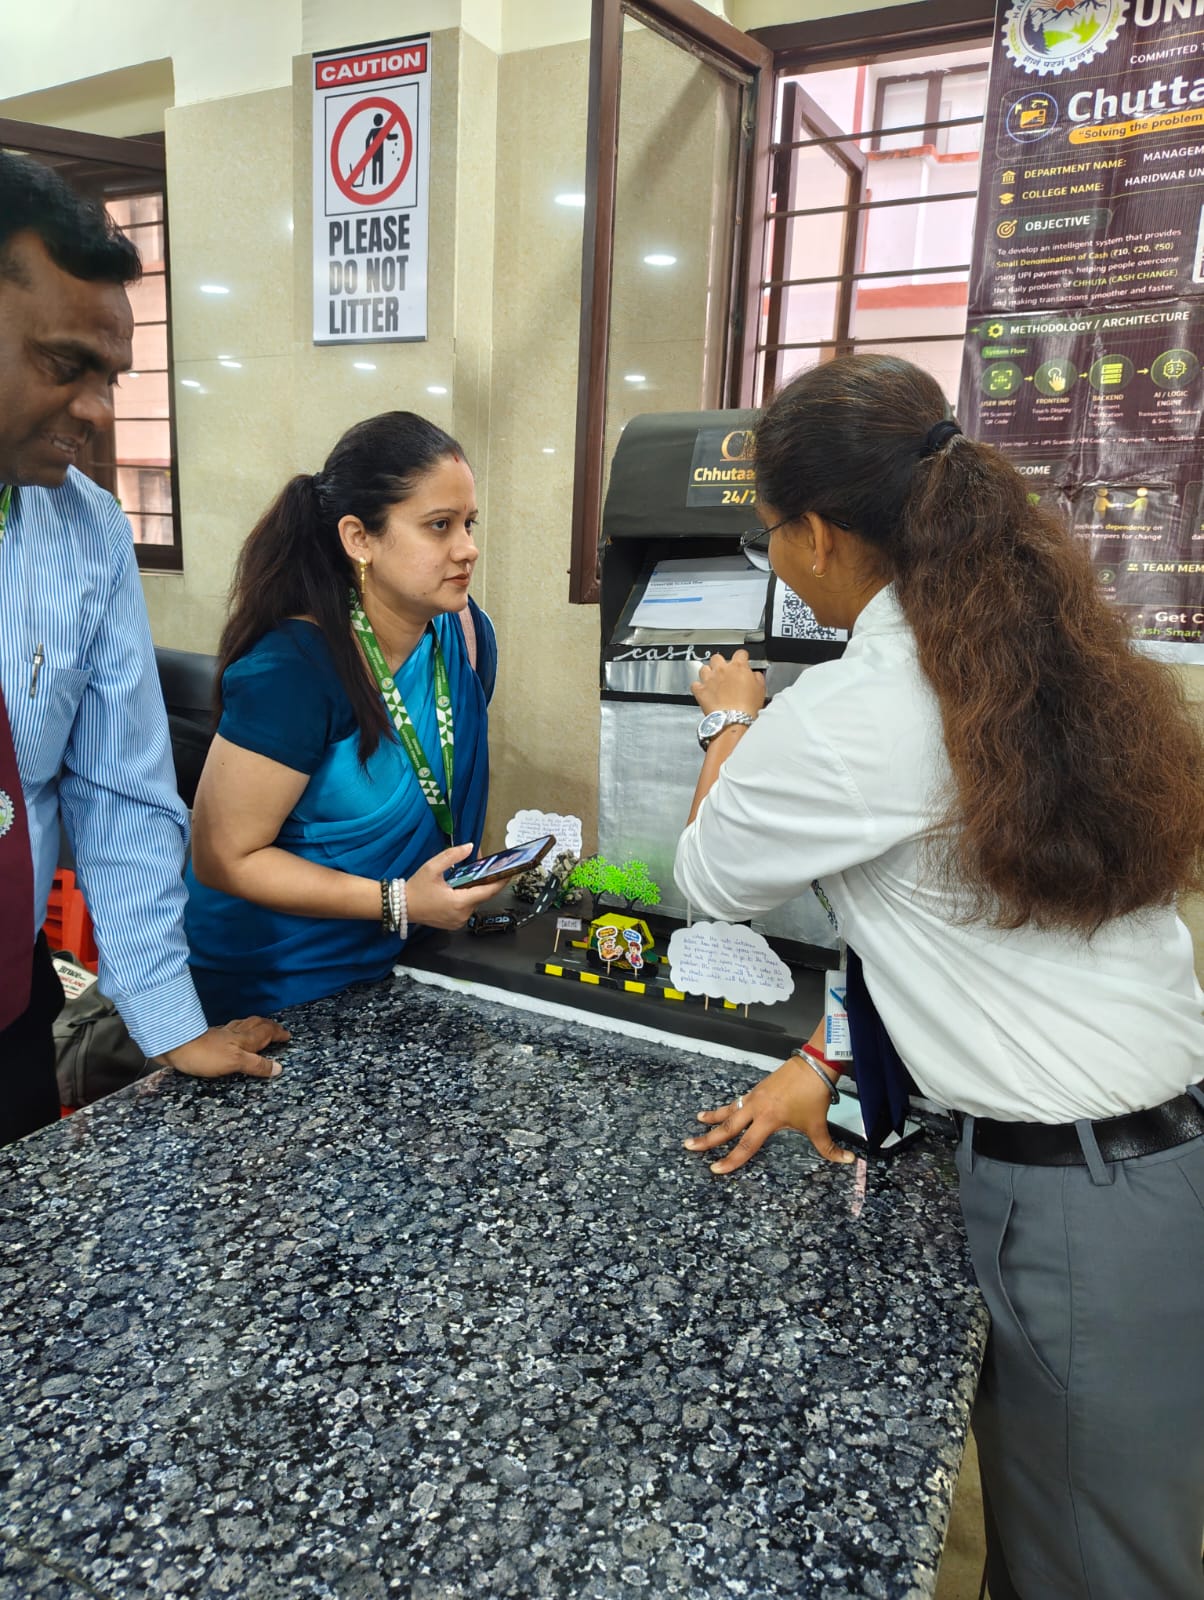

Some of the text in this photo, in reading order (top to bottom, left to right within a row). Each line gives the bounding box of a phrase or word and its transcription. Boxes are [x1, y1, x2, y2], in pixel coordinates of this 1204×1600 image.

[1130, 44, 1198, 64] COMMITTED
[321, 52, 421, 82] CAUTION
[1068, 75, 1204, 122] Chutta
[1130, 121, 1148, 132] the
[1152, 113, 1203, 130] problem
[1024, 163, 1090, 179] DEPARTMENT
[1093, 159, 1126, 170] NAME:
[1022, 186, 1071, 200] COLLEGE
[1073, 182, 1104, 194] NAME:
[1124, 170, 1185, 187] HARIDWAR
[1025, 215, 1091, 231] OBJECTIVE
[329, 214, 410, 256] PLEASE
[1008, 245, 1039, 255] develop
[1052, 240, 1093, 251] intelligent
[1095, 236, 1123, 247] system
[1125, 233, 1143, 242] that
[1144, 228, 1182, 241] provides
[994, 256, 1179, 282] using UPI payments, helping people overcome
[996, 261, 1018, 269] Small
[1020, 255, 1076, 267] Denomination
[1088, 251, 1109, 260] Cash
[329, 255, 408, 296] DO NOT
[993, 269, 1178, 294] the daily problem of CHHUTA (CASH CHANGE)
[1008, 298, 1037, 306] making
[1039, 293, 1088, 303] transactions
[1090, 289, 1128, 300] smoother
[1130, 286, 1147, 295] and
[329, 296, 399, 335] LITTER
[1010, 318, 1092, 335] METHODOLOGY
[1102, 311, 1190, 328] ARCHITECTURE
[1036, 397, 1070, 405] FRONTEND
[1092, 394, 1124, 402] BACKEND
[1167, 390, 1189, 398] LOGIC
[1105, 523, 1151, 531] dependency
[1134, 533, 1162, 541] change
[1142, 563, 1174, 572] TEAM
[1155, 611, 1187, 623] Get
